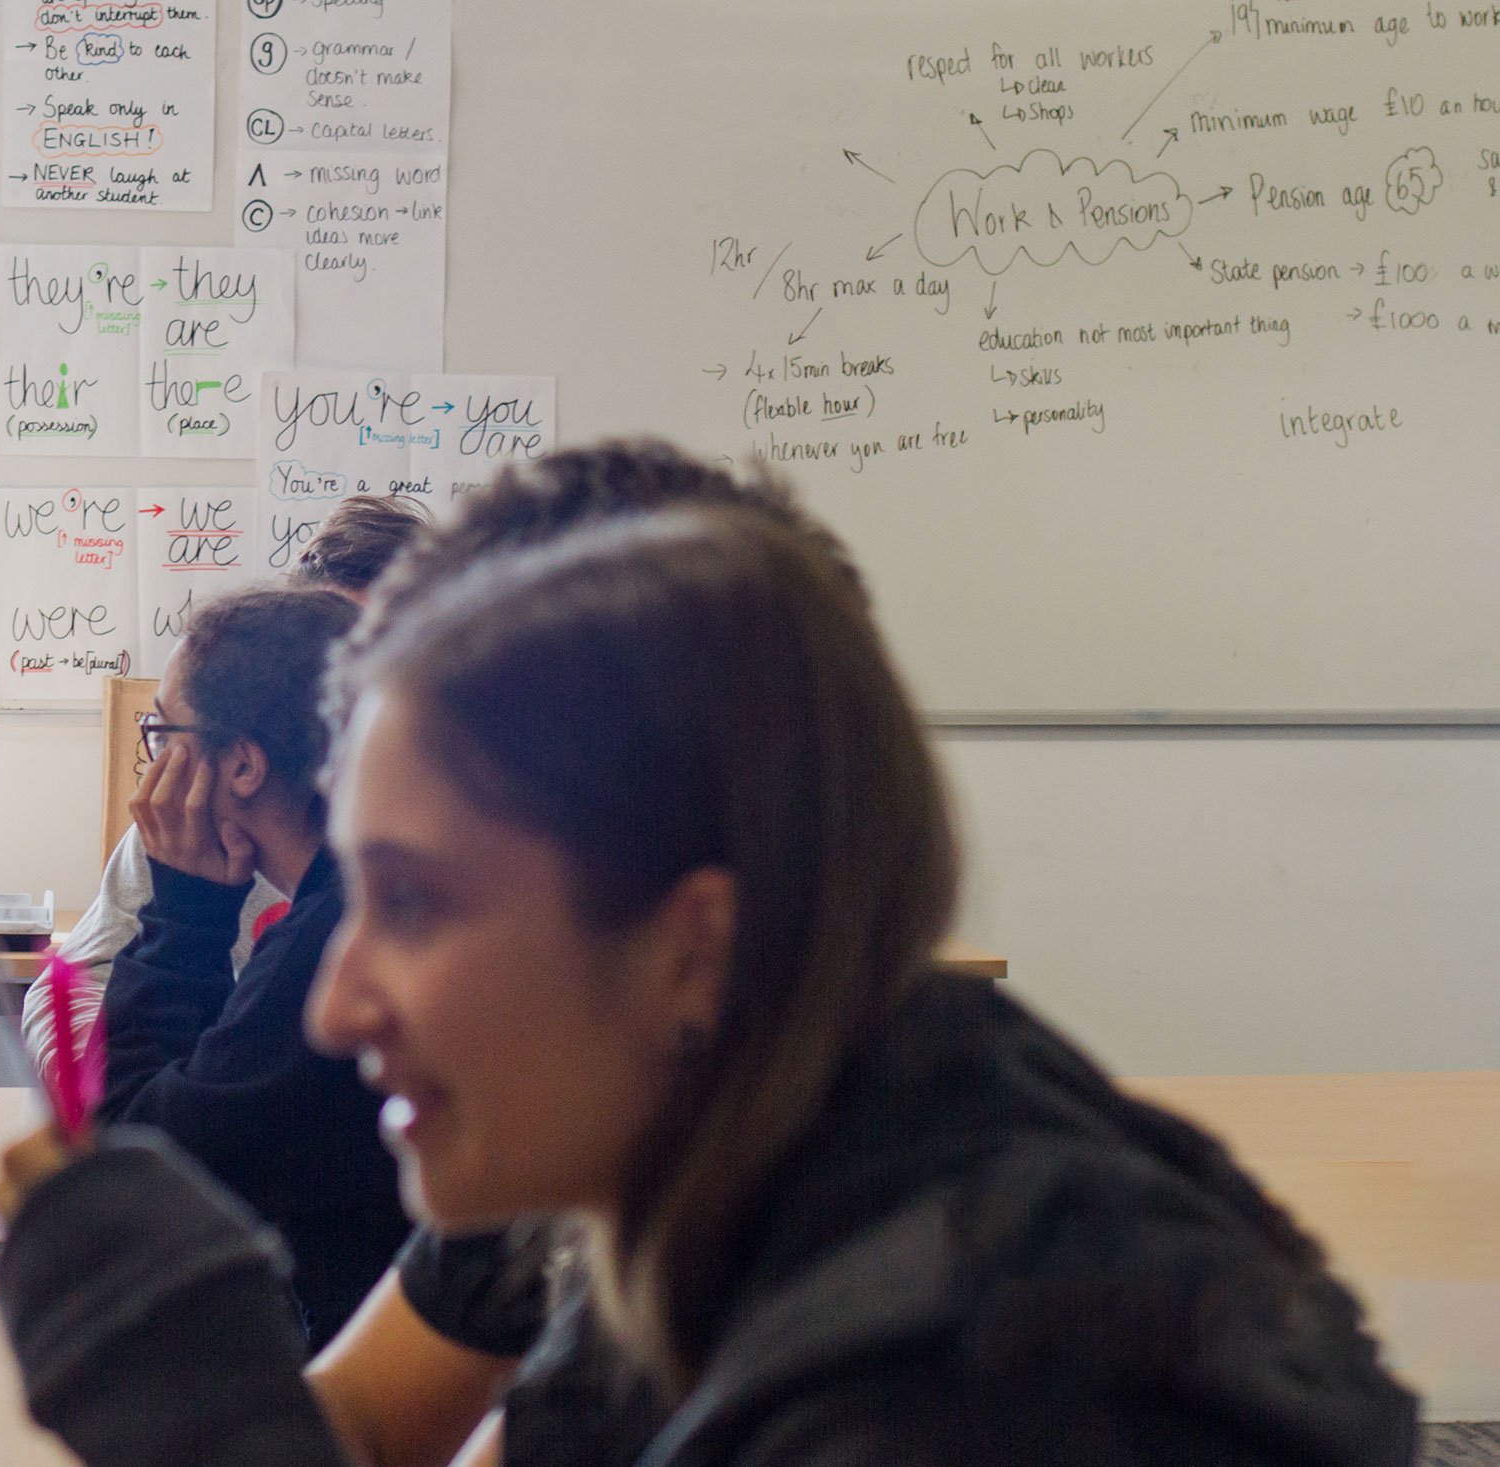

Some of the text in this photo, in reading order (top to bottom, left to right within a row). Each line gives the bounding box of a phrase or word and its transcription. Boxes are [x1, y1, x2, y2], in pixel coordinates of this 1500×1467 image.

[41, 10, 83, 25] don't
[96, 8, 159, 28] interrupt
[1265, 18, 1354, 36] minimum
[1374, 17, 1409, 47] age
[1426, 1, 1446, 29] to
[46, 35, 191, 60] Be kind to each
[312, 41, 395, 64] grammar
[907, 41, 1153, 85] respect for all workers
[306, 67, 422, 85] doesn't make
[43, 94, 179, 128] Speak only in
[251, 118, 276, 136] CL
[1190, 106, 1288, 133] minimum
[1310, 105, 1357, 136] wage
[1384, 86, 1424, 117] £10
[1440, 100, 1462, 116] an
[34, 163, 192, 191] NEVER laugh at
[36, 185, 89, 200] another
[310, 166, 380, 194] missing
[395, 165, 441, 185] word
[1250, 166, 1425, 222] Pension age 65
[412, 200, 443, 221] link
[950, 187, 1032, 238] Work
[1077, 186, 1171, 229] Pensions
[306, 228, 400, 245] ideas more
[711, 237, 757, 275] 12hr
[783, 269, 819, 302] 8hr
[834, 279, 876, 298] max
[894, 279, 906, 296] a
[916, 271, 949, 315] day
[1273, 260, 1341, 290] pension
[1374, 249, 1428, 286] £100
[1461, 265, 1475, 279] a
[8, 256, 256, 334] they're they
[1368, 297, 1440, 331] £1000
[1458, 315, 1473, 332] a
[166, 319, 229, 347] are
[979, 314, 1291, 351] education not most important thing
[841, 351, 895, 375] breaks
[4, 359, 252, 411] their there
[6, 413, 231, 440] (possession) (place)
[274, 385, 543, 455] you're you
[1023, 399, 1105, 434] personality
[1280, 398, 1404, 449] integrate
[372, 432, 405, 449] missing
[486, 432, 546, 460] are
[851, 444, 885, 473] you
[898, 433, 922, 450] are
[932, 421, 969, 447] free
[277, 465, 339, 496] You're
[357, 480, 371, 493] a
[389, 476, 433, 497] great
[5, 497, 237, 538] we're we
[74, 537, 124, 556] missing
[169, 536, 239, 566] are
[269, 514, 321, 568] yo
[12, 605, 116, 641] were
